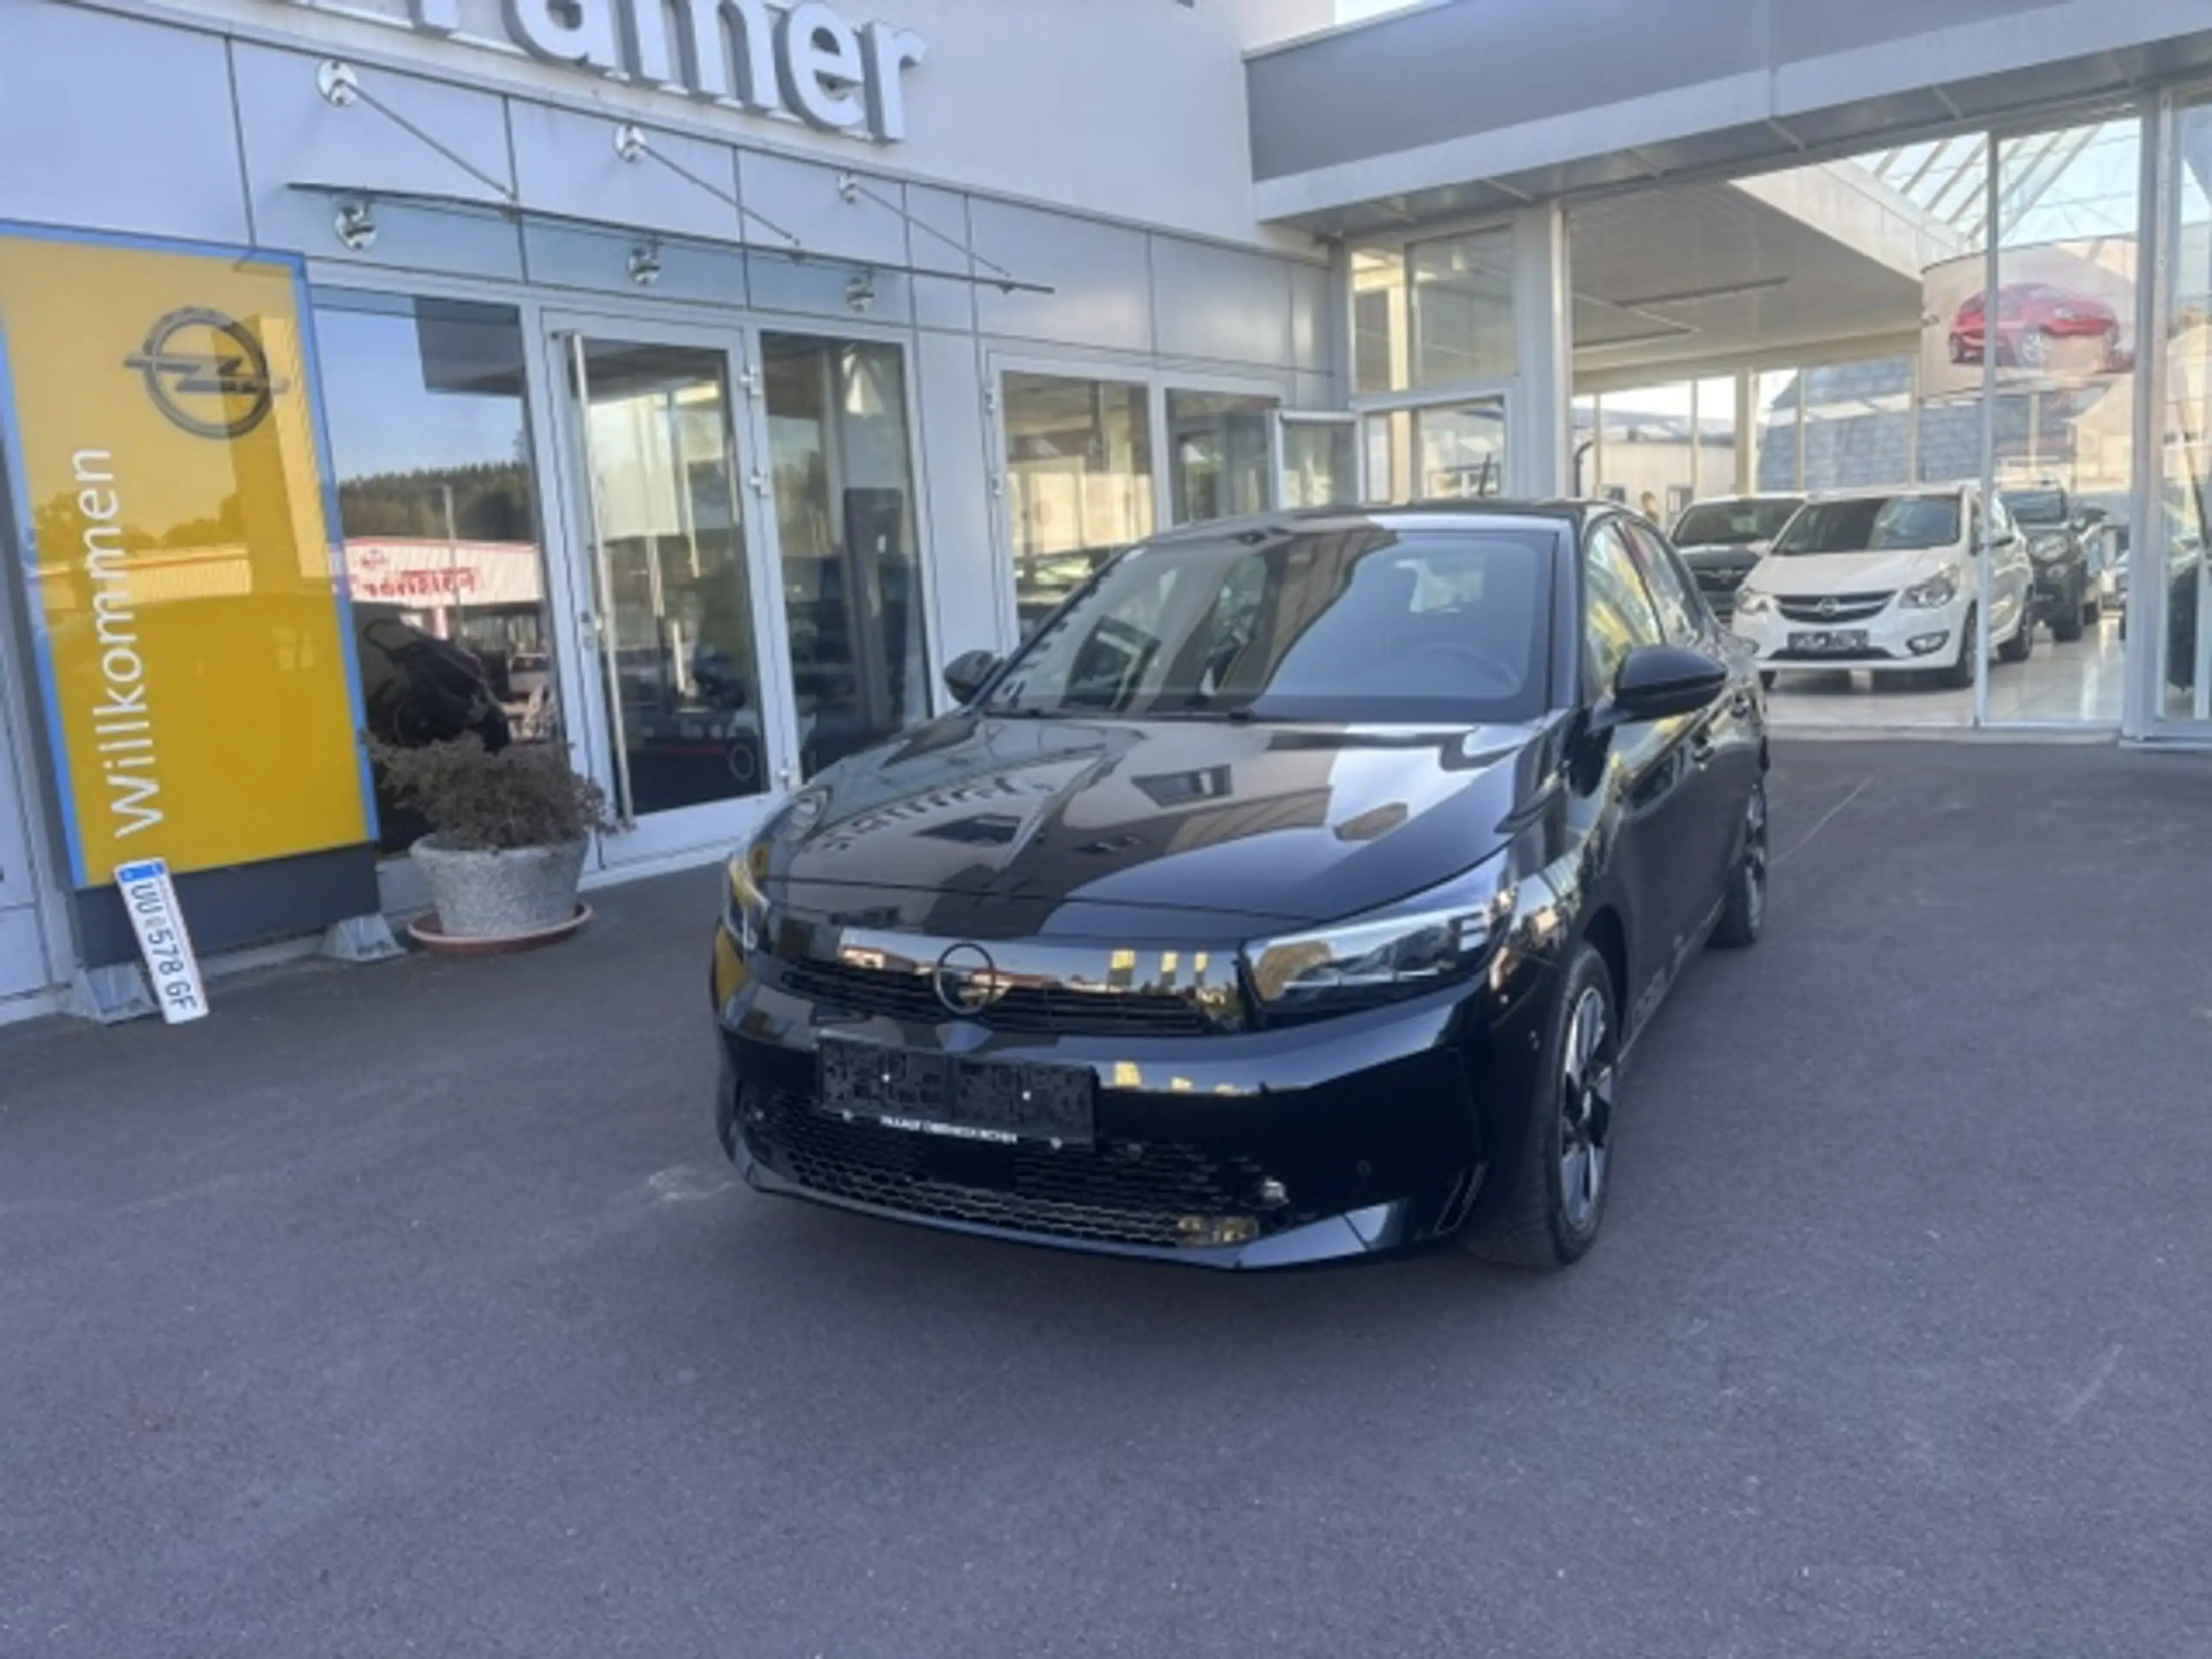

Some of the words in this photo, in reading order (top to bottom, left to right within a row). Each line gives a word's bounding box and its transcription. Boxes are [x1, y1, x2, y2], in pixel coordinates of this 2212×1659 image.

[408, 0, 927, 144] amer
[72, 448, 164, 839] Willkommen
[147, 928, 184, 974] 578
